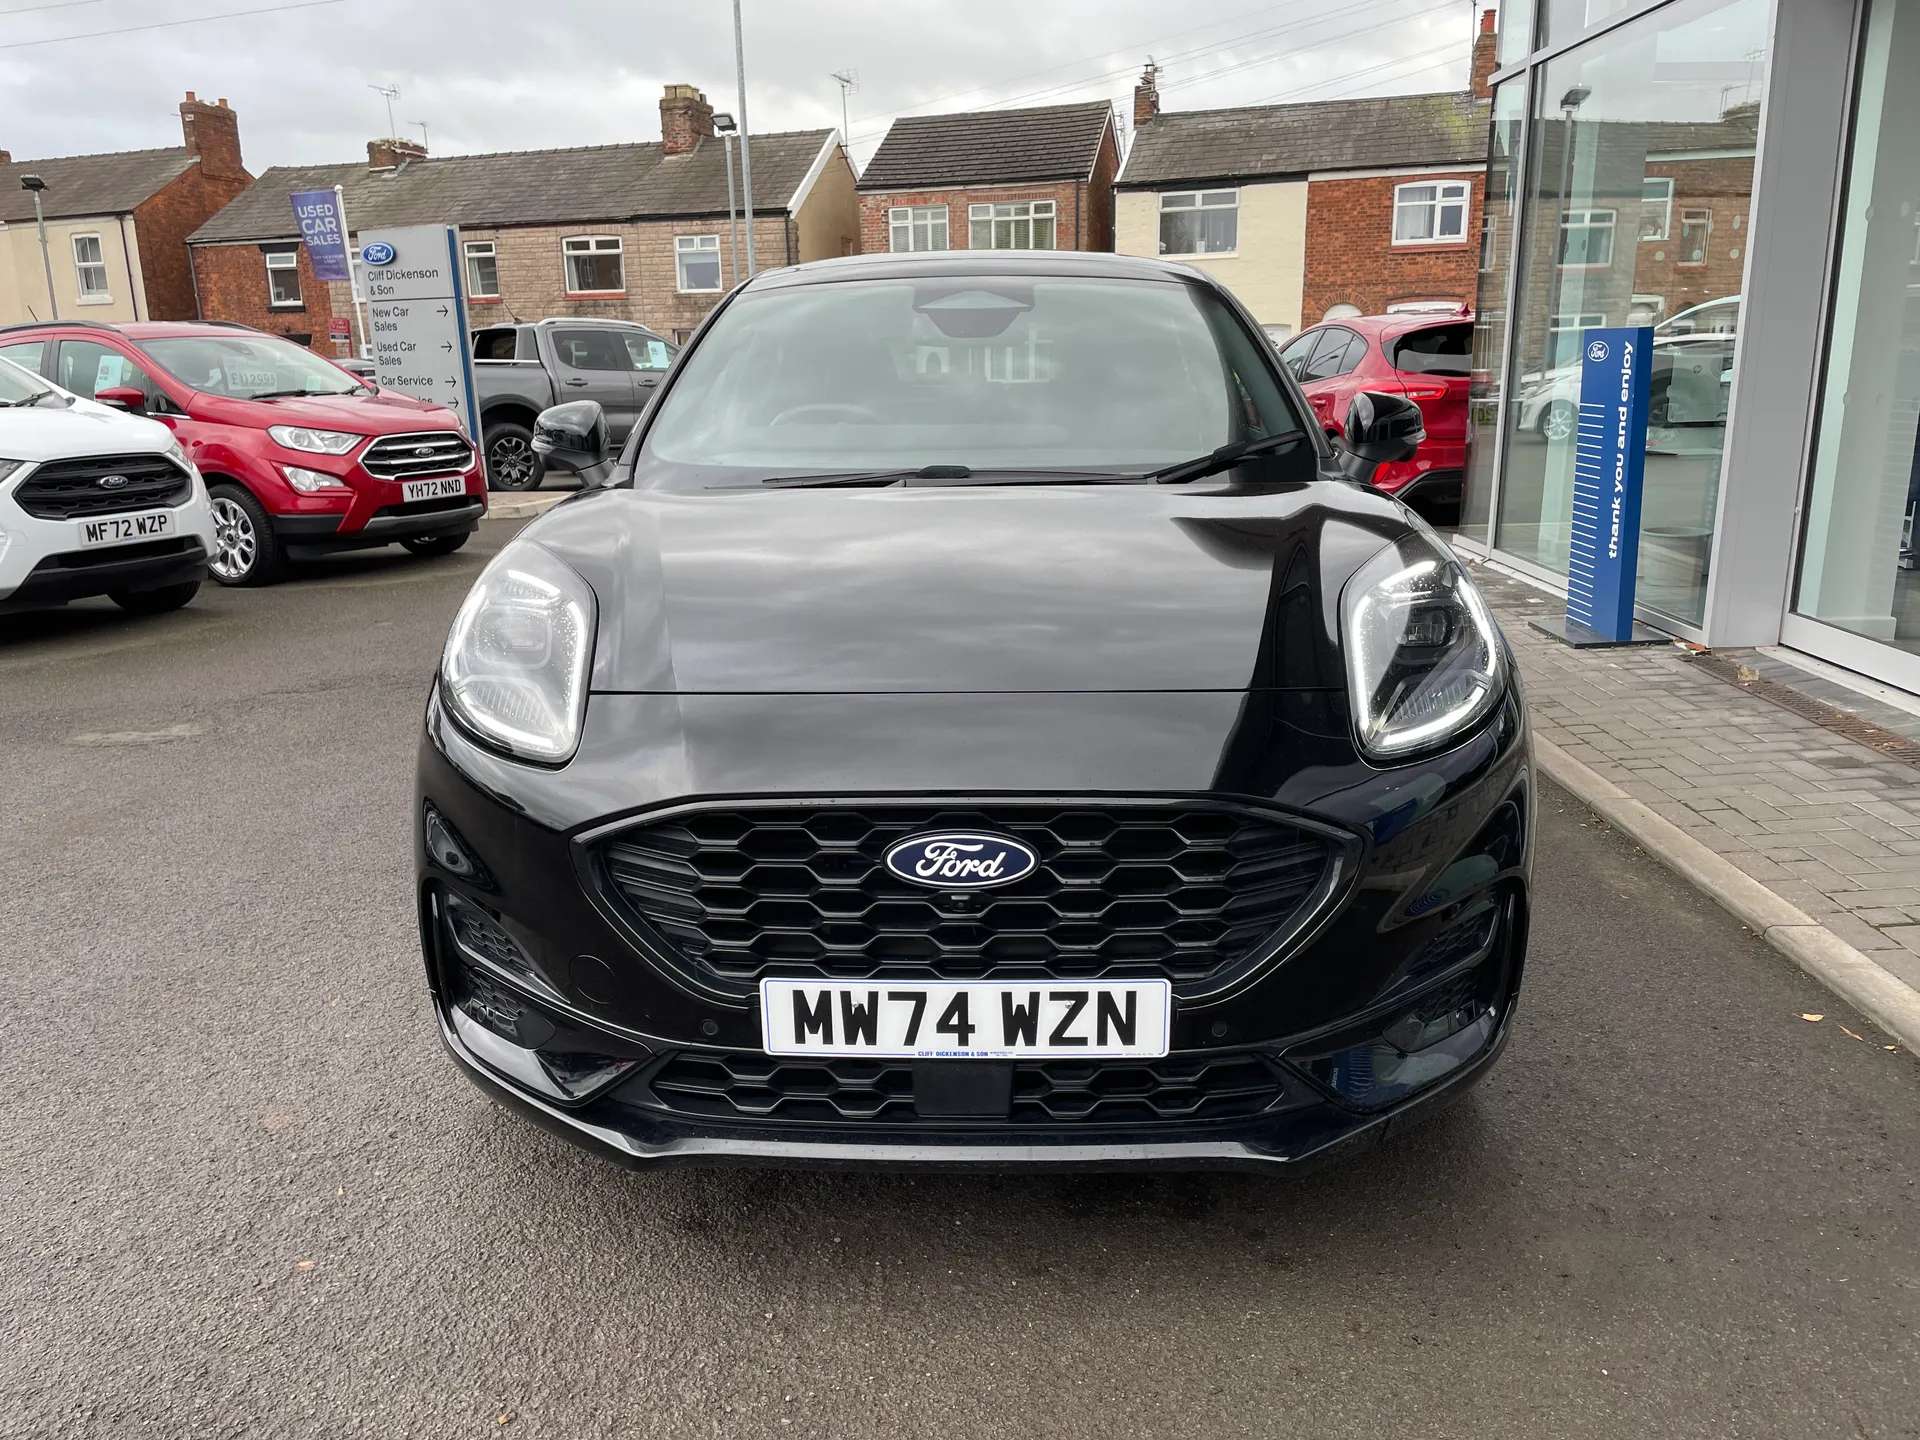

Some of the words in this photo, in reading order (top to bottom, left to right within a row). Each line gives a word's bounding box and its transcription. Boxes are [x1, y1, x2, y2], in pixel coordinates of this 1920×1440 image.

[297, 204, 334, 218] USED
[302, 217, 338, 234] CAR
[306, 233, 341, 246] SALES
[367, 246, 388, 261] Ford
[367, 269, 385, 281] Cliff
[386, 268, 439, 281] Dickenson
[370, 285, 376, 296] &
[377, 284, 395, 296] Son
[372, 306, 391, 318] New
[392, 306, 409, 317] Car
[374, 321, 398, 332] Sales
[376, 341, 398, 353] Used
[399, 341, 417, 352] Car
[378, 355, 402, 366] Sales
[1621, 341, 1634, 402] enjoy
[381, 375, 396, 386] Car
[397, 375, 434, 386] Service
[1617, 406, 1628, 450] and
[1614, 454, 1625, 493] you
[407, 482, 439, 499] YH72
[440, 479, 462, 495] NND
[85, 520, 134, 542] MF72
[136, 515, 168, 535] WZP
[1608, 496, 1621, 559] thank
[915, 841, 1005, 878] Ford
[792, 989, 976, 1047] MW74
[1000, 990, 1137, 1047] WZN
